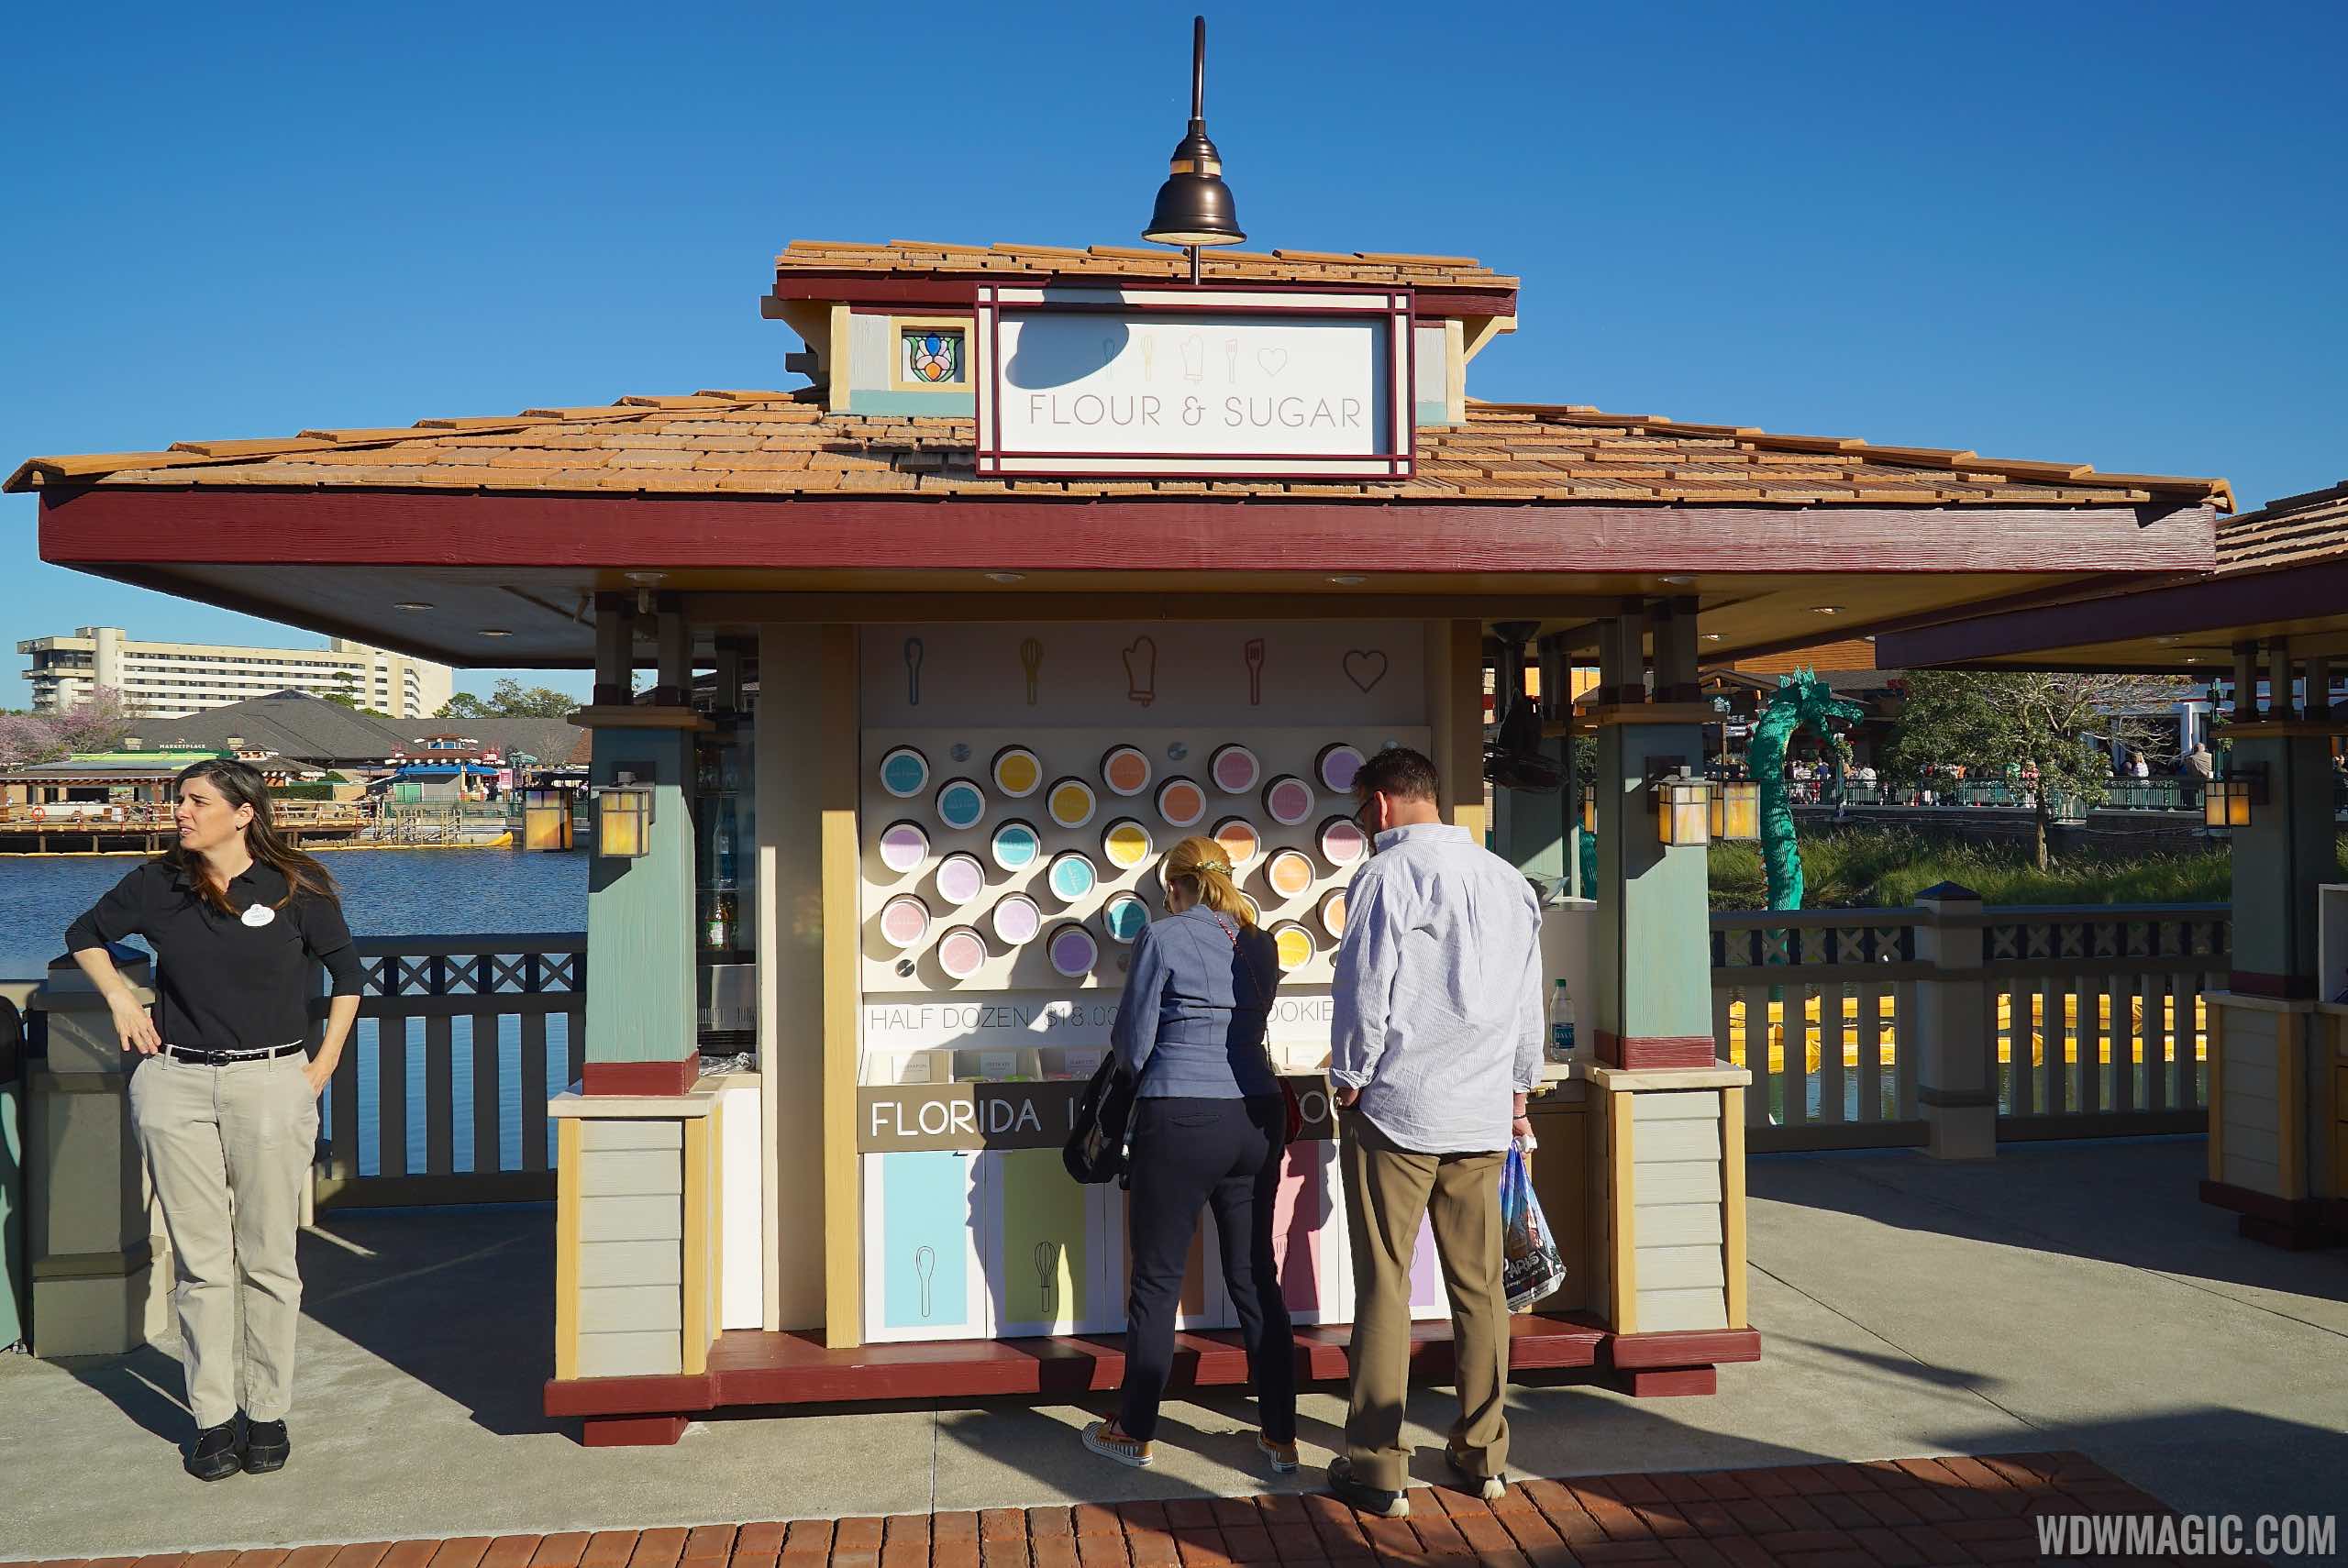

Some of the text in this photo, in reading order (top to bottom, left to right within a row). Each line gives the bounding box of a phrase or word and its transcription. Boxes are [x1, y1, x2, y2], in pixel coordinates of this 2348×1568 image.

[1030, 394, 1360, 428] FLOUR & SUGAR
[871, 1008, 934, 1030] HALF
[943, 1007, 1029, 1029] DOZEN
[1266, 1000, 1335, 1022] OOKIE
[871, 1099, 1042, 1137] FLORIDA
